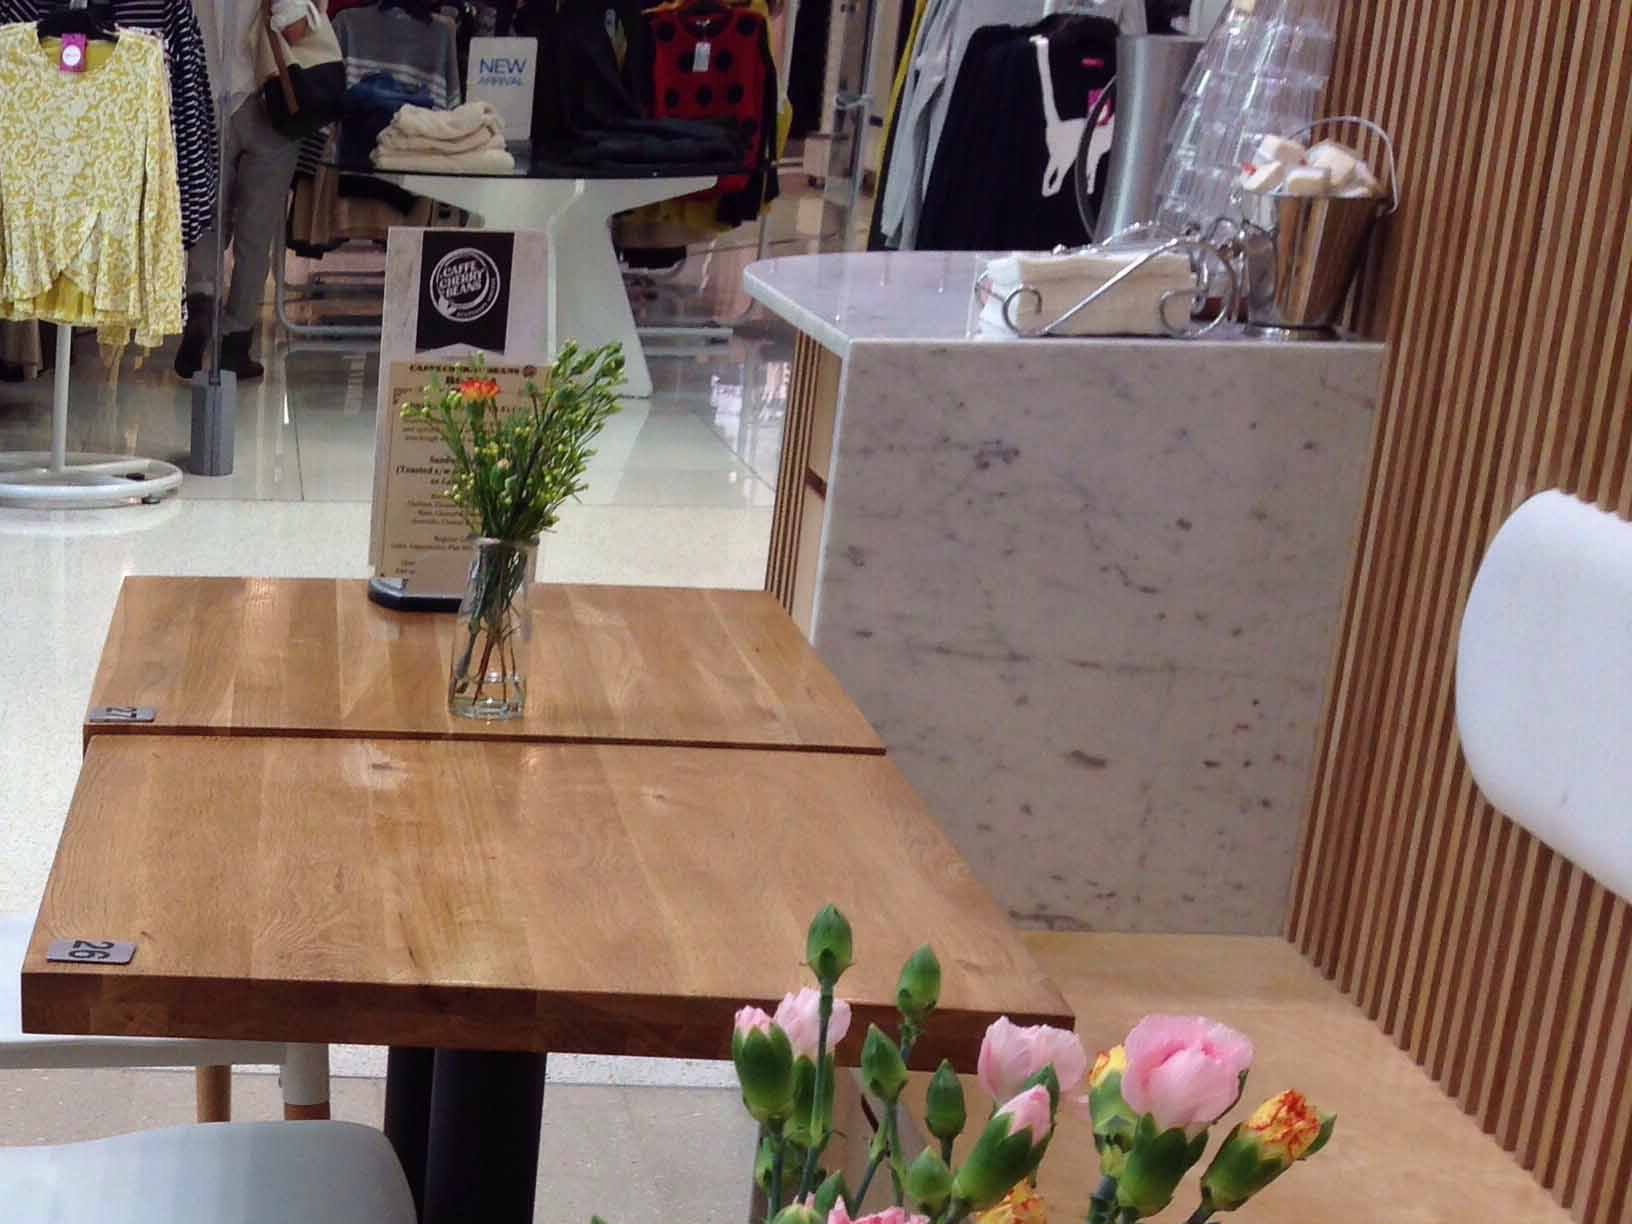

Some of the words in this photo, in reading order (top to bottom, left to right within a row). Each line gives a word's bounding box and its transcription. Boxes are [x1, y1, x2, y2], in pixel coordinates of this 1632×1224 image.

[480, 57, 528, 74] NEW
[445, 281, 482, 298] BEANS
[69, 940, 115, 959] 26
